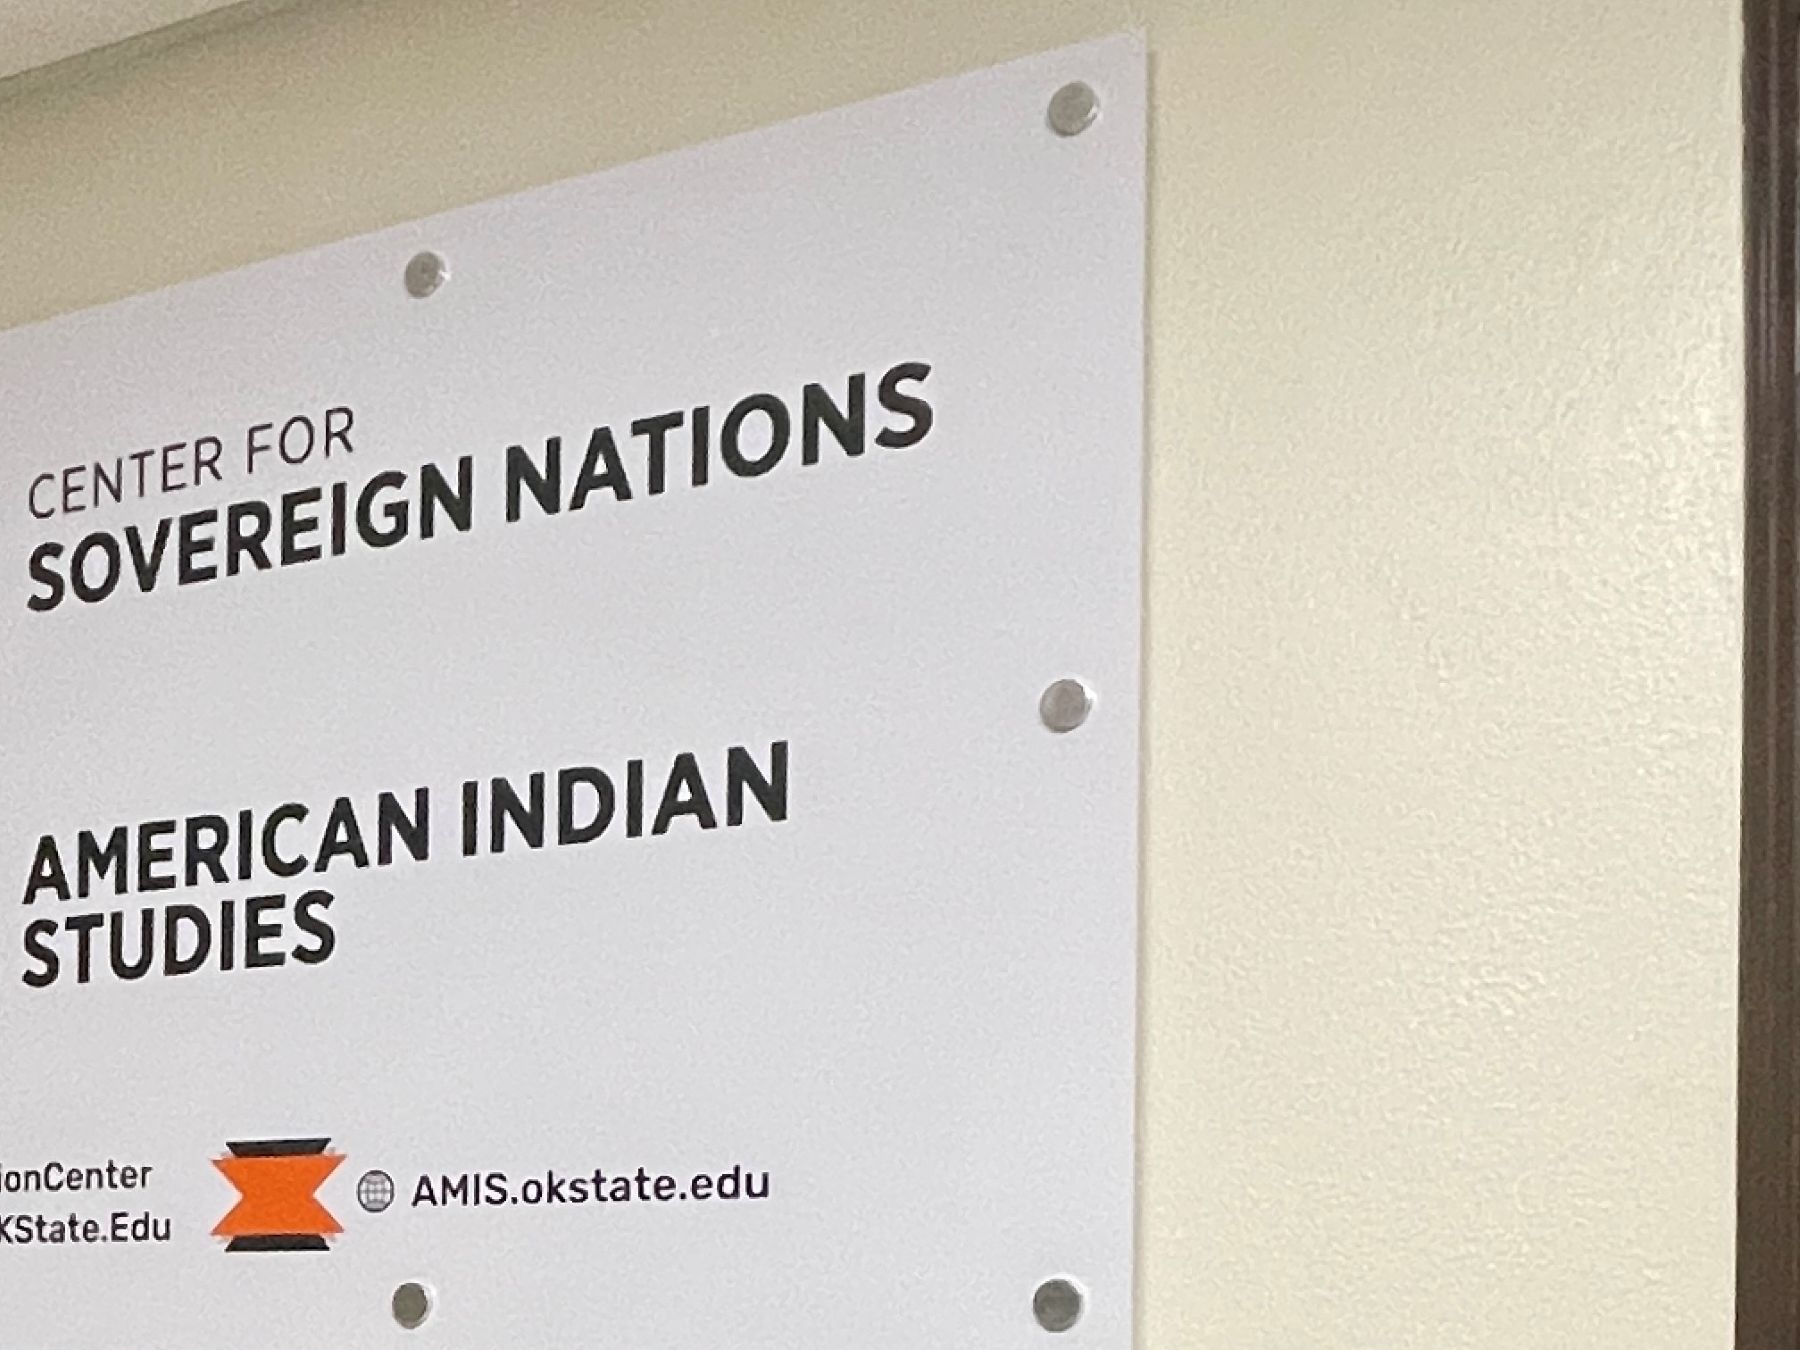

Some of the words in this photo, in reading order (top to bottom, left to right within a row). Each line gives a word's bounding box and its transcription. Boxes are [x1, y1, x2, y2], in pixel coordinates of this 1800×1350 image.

[27, 455, 474, 612] SOVEREIGN
[505, 362, 933, 523] NATIONS
[28, 436, 224, 520] CENTER
[247, 407, 355, 475] FOR
[21, 787, 430, 905] AMERICAN
[462, 741, 789, 858] INDIAN
[21, 889, 337, 988] STUDIES
[411, 1164, 770, 1207] AMIS.okstate.edu
